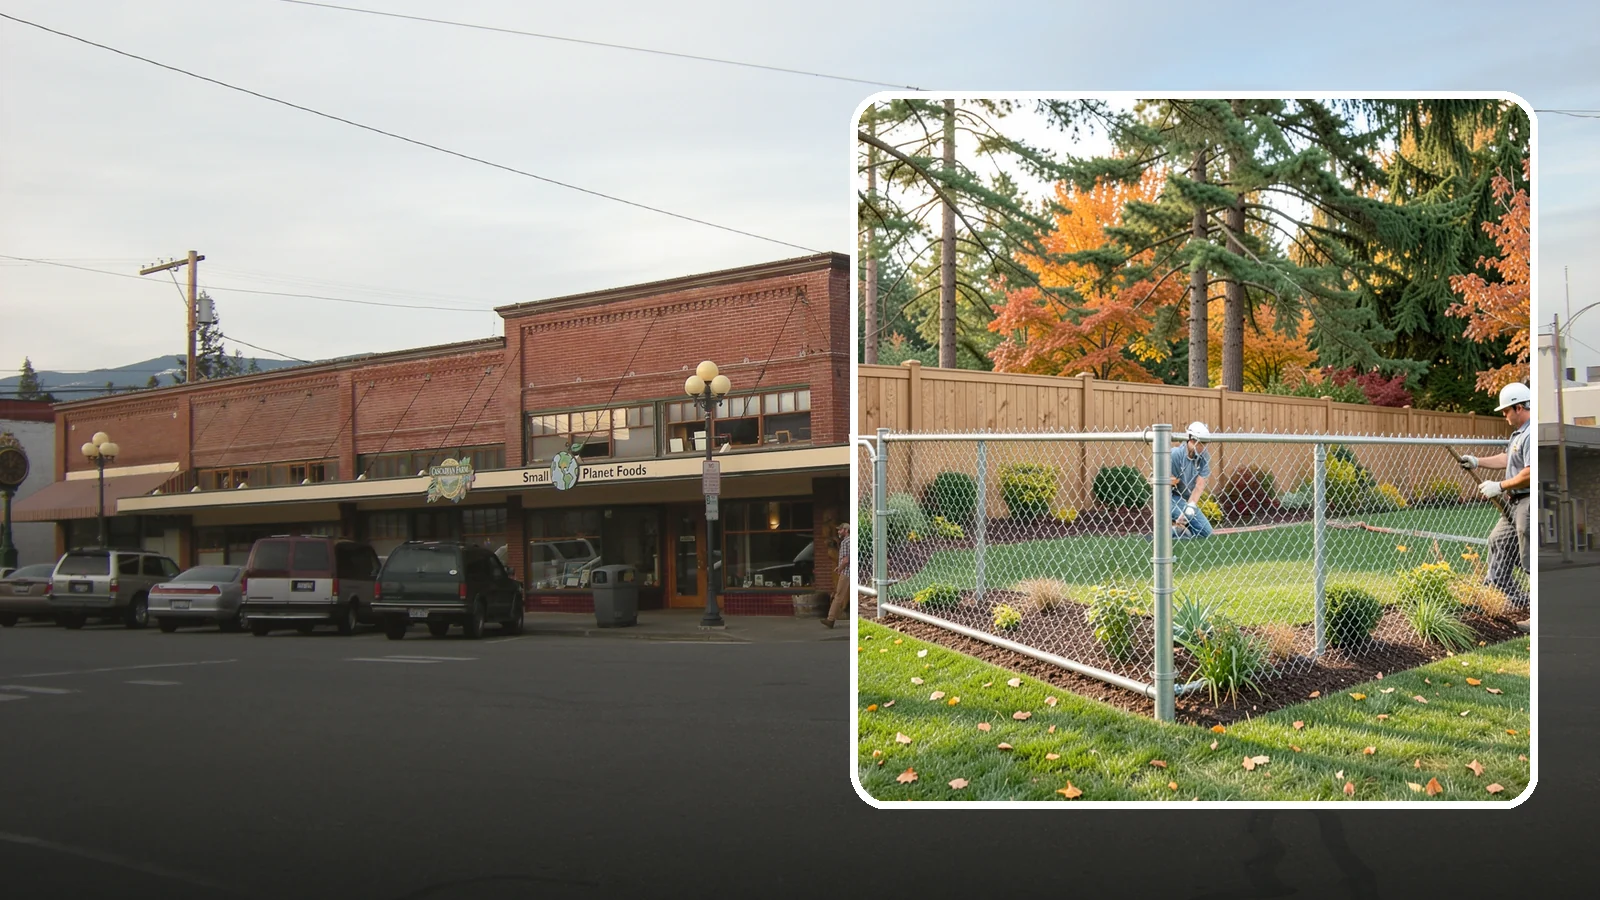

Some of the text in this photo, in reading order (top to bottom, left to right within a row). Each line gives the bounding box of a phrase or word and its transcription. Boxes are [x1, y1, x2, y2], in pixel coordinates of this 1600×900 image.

[523, 464, 647, 483] Small Planet Foods
